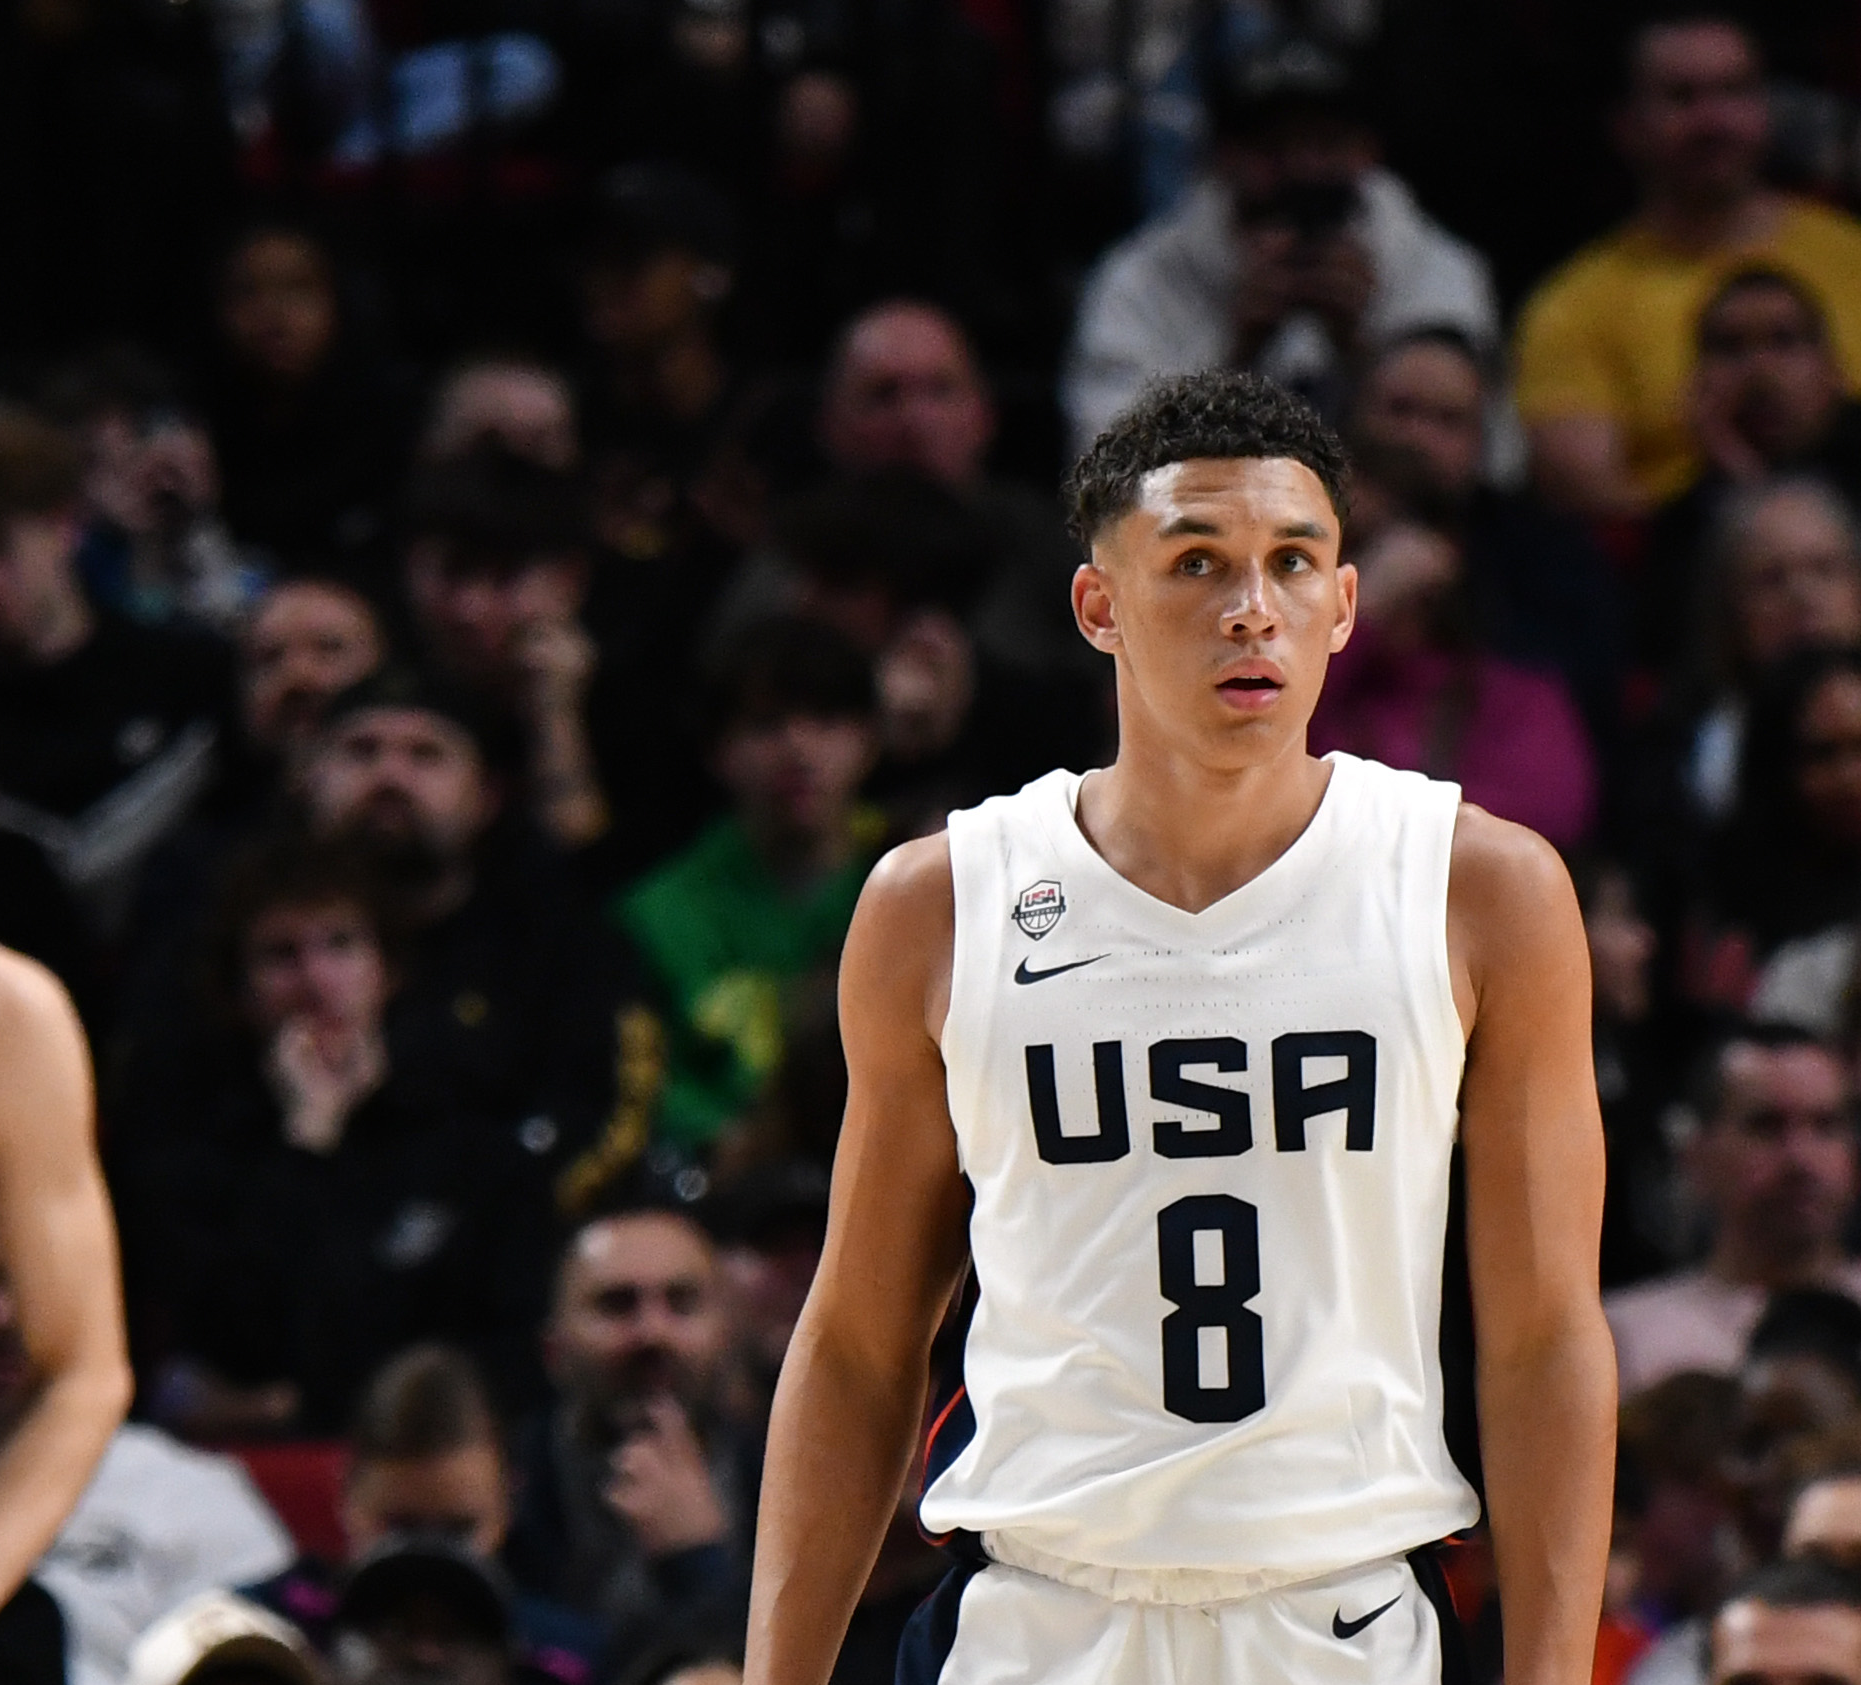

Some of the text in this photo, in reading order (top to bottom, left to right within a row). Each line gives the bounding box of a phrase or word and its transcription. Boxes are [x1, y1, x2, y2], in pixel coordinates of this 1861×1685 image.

[1024, 888, 1057, 908] USA
[1025, 1030, 1378, 1165] USA
[1157, 1194, 1266, 1423] 8
